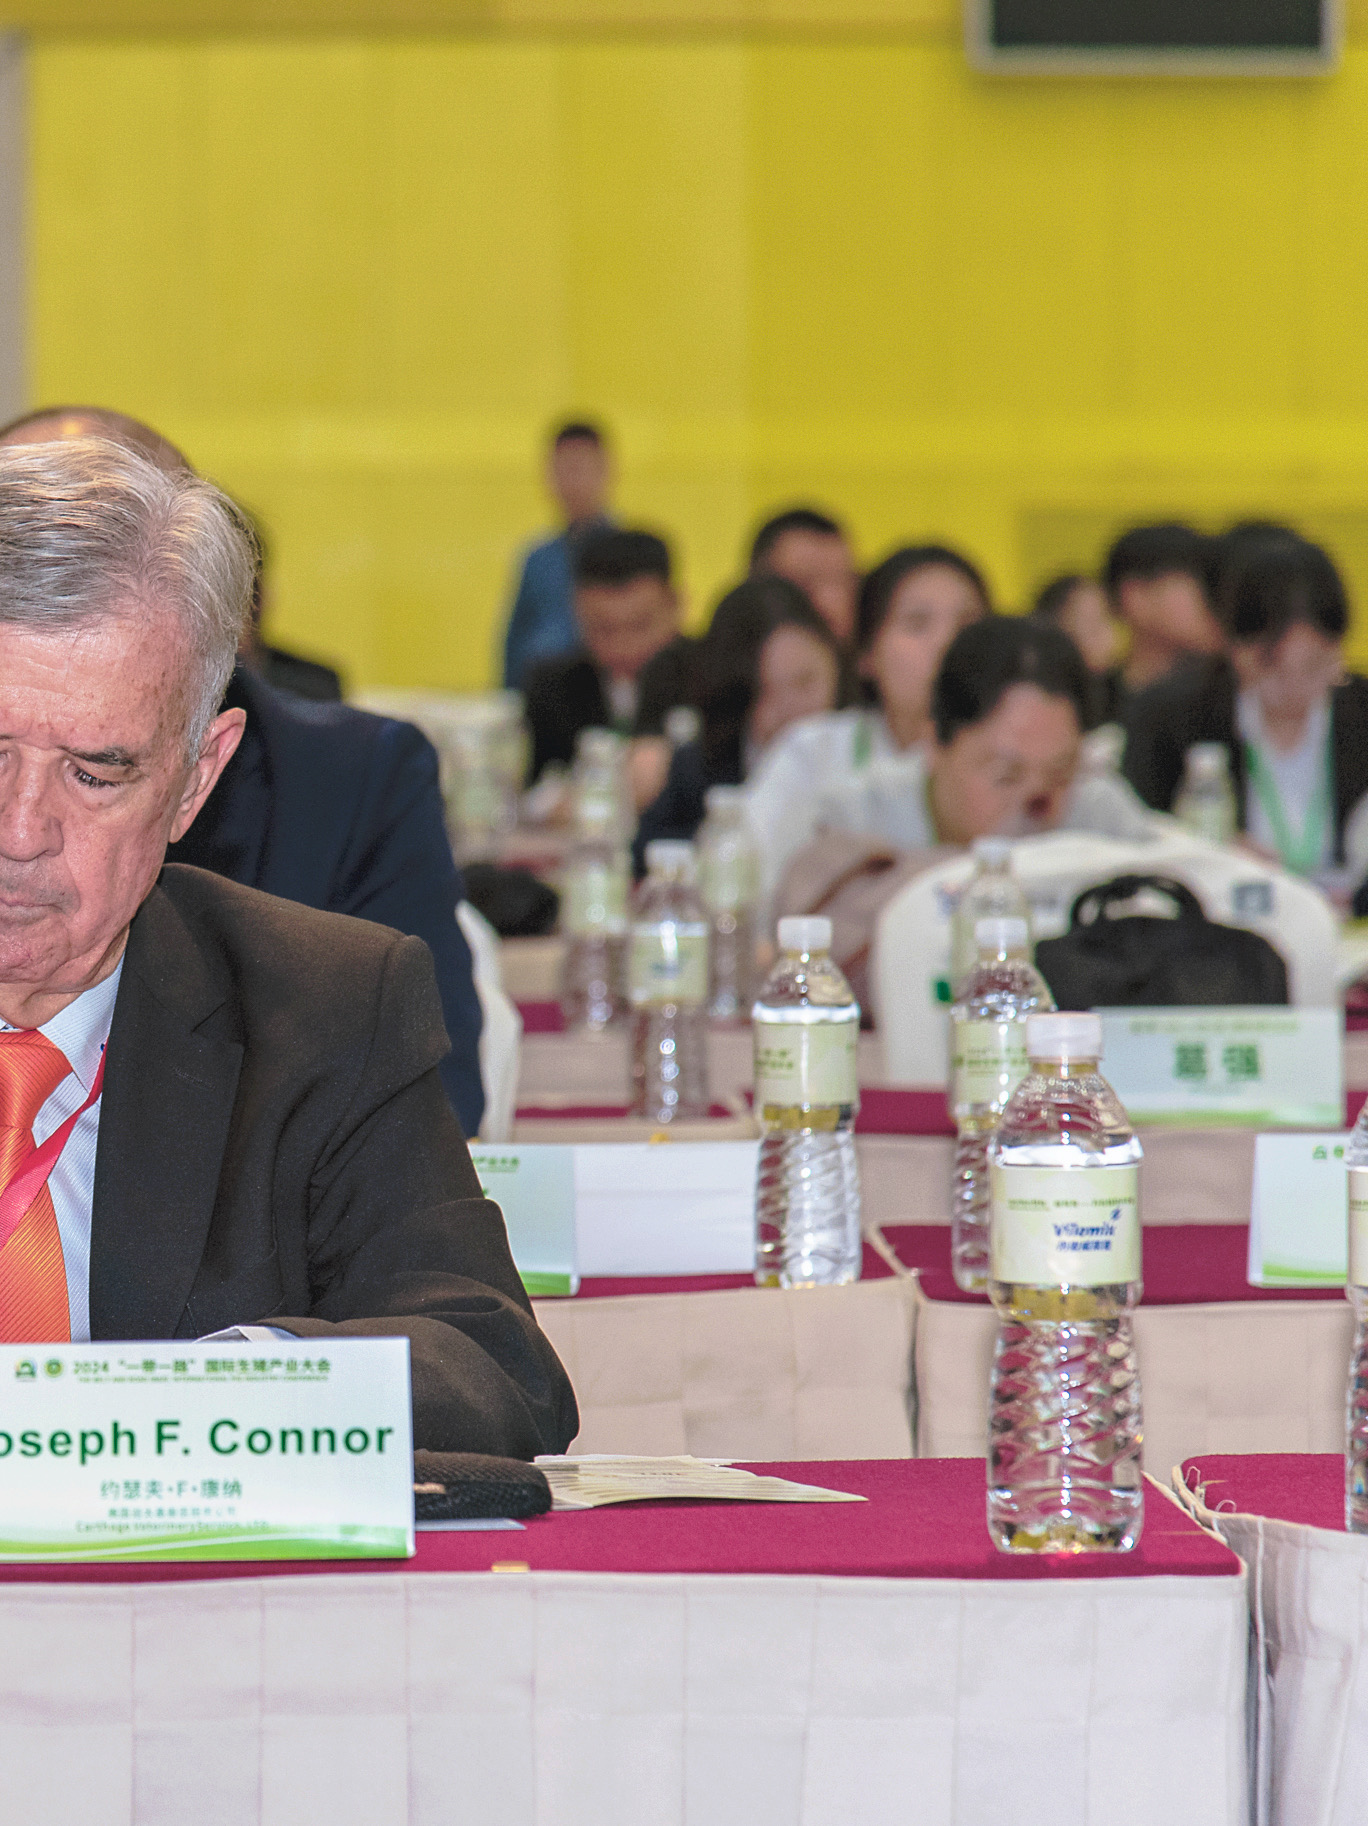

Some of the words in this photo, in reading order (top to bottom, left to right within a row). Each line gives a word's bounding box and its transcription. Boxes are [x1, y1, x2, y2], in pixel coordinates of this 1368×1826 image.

[73, 1361, 110, 1374] 2024
[118, 1359, 195, 1373] “一带一路”
[204, 1358, 332, 1374] 国际生猪产业大会
[154, 1420, 191, 1456] F.
[208, 1419, 395, 1456] Connor
